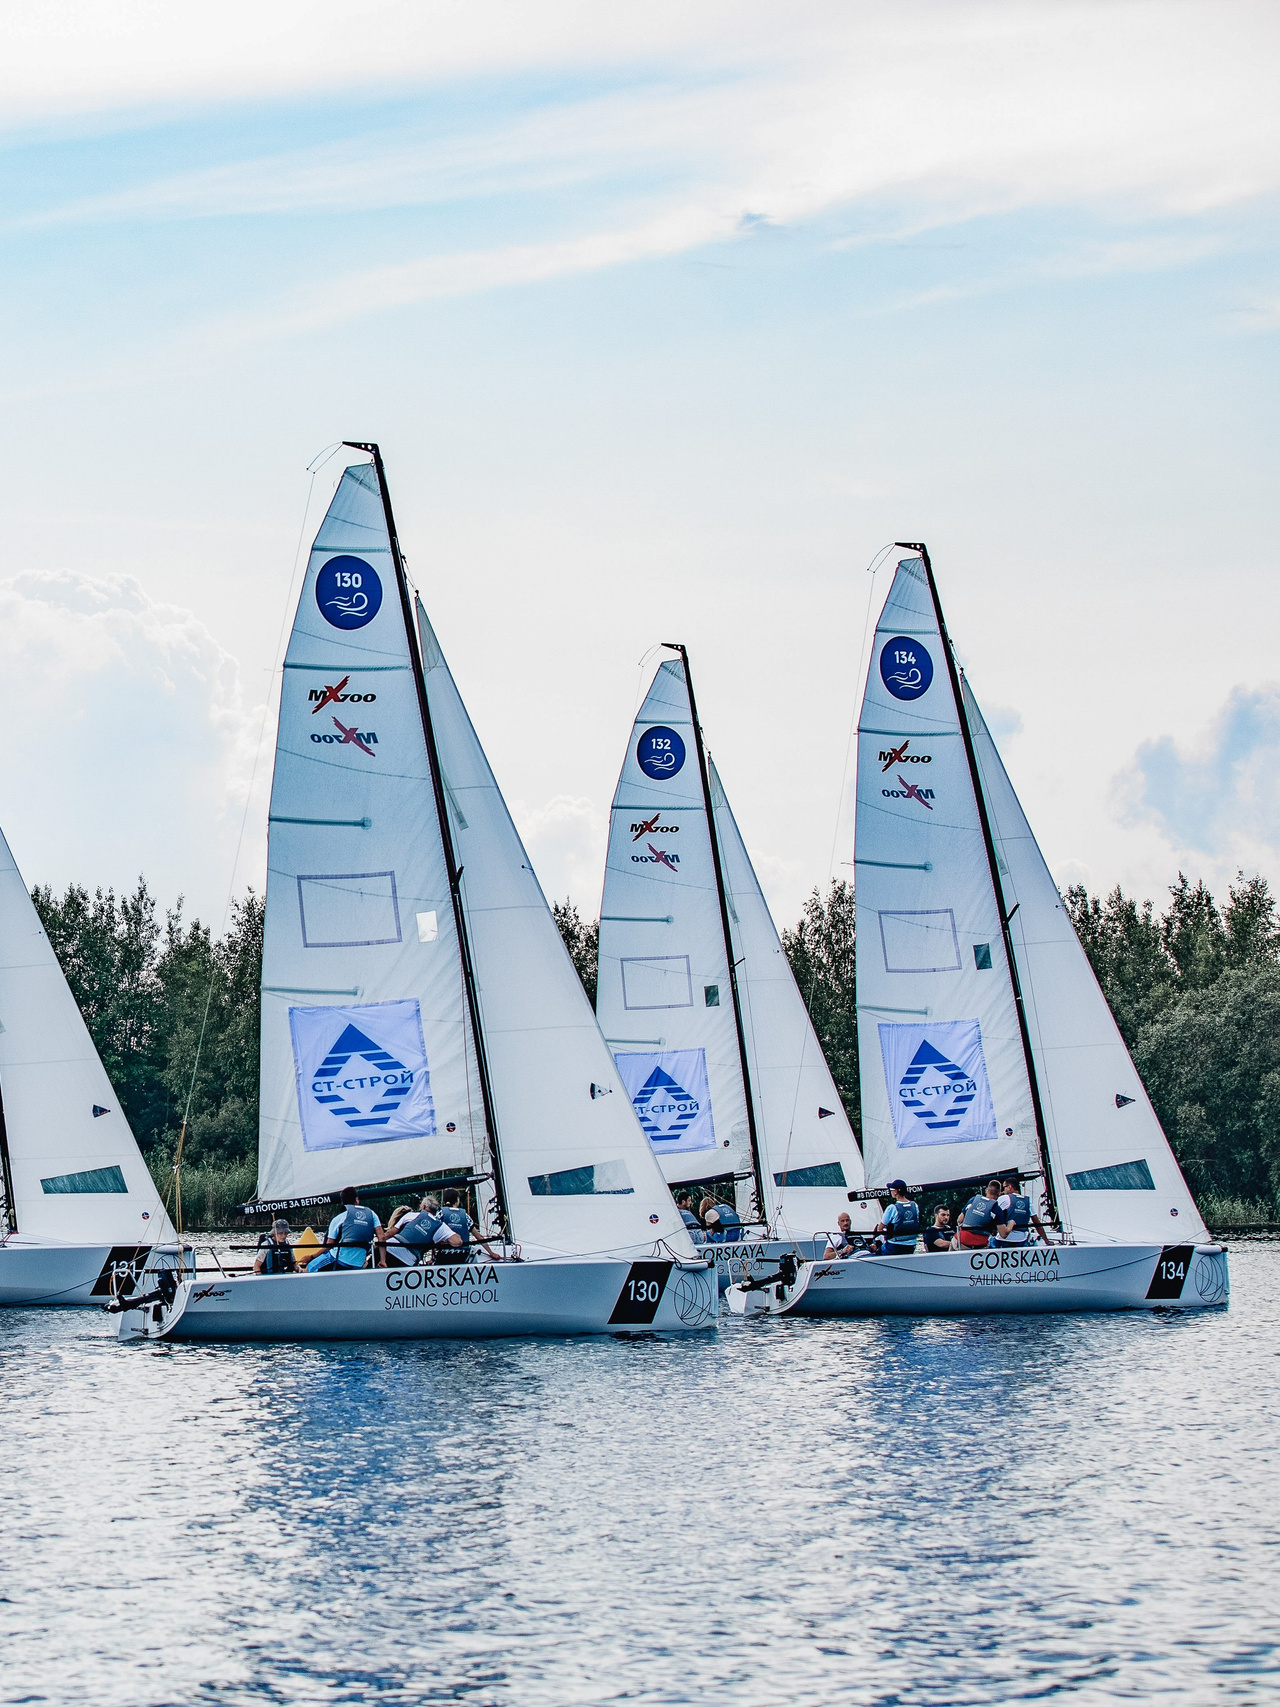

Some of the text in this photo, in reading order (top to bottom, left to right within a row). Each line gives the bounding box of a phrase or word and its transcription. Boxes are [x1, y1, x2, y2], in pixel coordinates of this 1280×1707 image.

[334, 572, 362, 588] 130
[894, 651, 916, 665] 134
[307, 675, 377, 715] MX700
[651, 738, 671, 750] 132
[878, 739, 932, 772] MX700
[629, 813, 679, 842] MX700
[312, 1070, 414, 1093] СТ-СТРОЙ
[899, 1079, 977, 1098] СТ-СТРОЙ
[255, 1201, 287, 1212] ПОГОНЕ
[289, 1200, 300, 1208] ЗА
[301, 1196, 331, 1206] ВЕТРОМ
[970, 1249, 1060, 1270] GORSKAYA
[386, 1265, 499, 1291] GORSKAYA
[969, 1270, 1060, 1286] SAILING SCHOOL
[1160, 1261, 1184, 1280] 134
[385, 1289, 499, 1310] SAILING SCHOOL
[628, 1280, 659, 1302] 130
